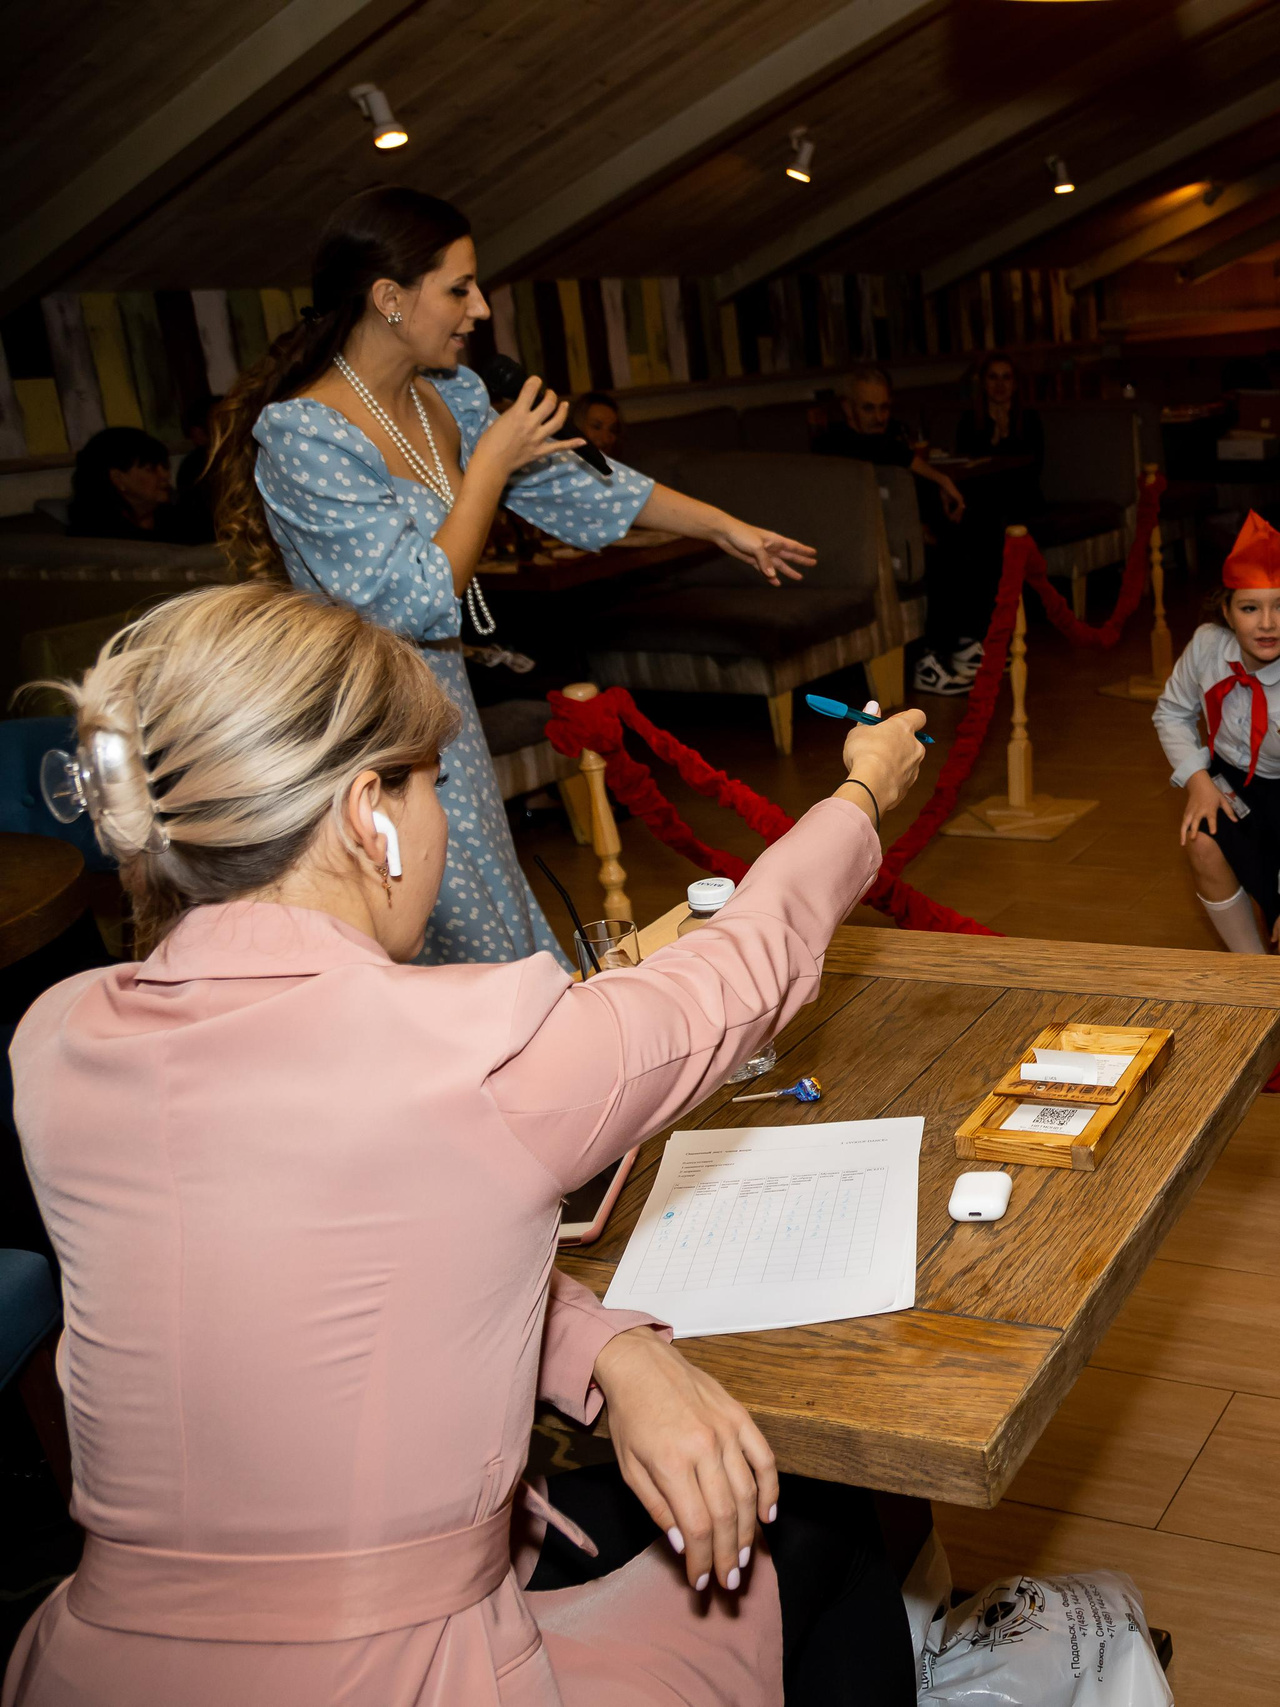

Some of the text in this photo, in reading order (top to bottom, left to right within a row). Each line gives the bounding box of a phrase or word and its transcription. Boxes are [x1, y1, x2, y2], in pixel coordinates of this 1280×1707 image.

[1065, 1609, 1076, 1622] ул.
[1075, 1607, 1089, 1637] +7(495)
[1068, 1623, 1081, 1670] Подольск,
[1097, 1640, 1106, 1673] Чехов,
